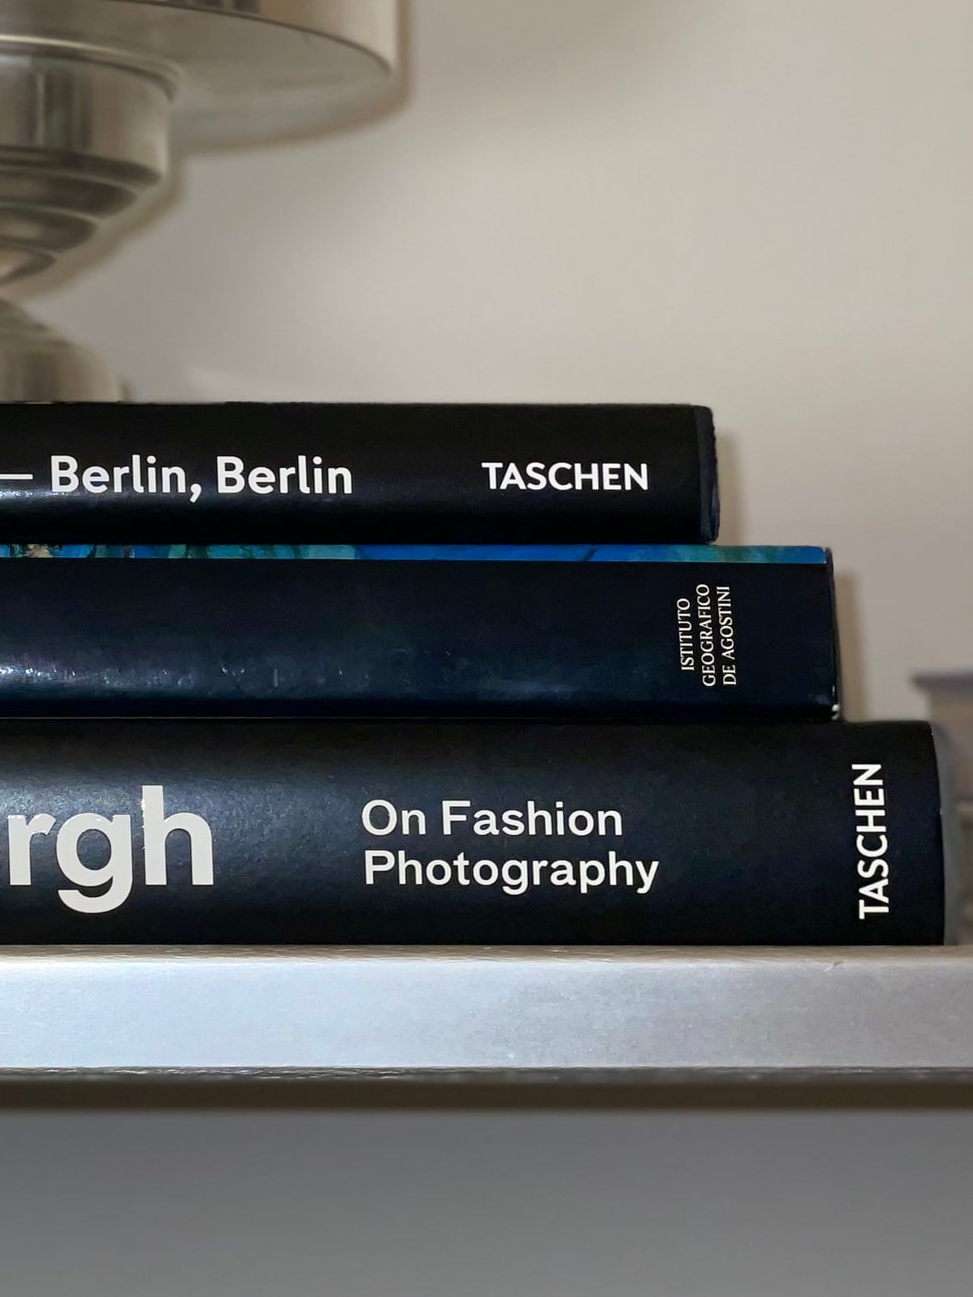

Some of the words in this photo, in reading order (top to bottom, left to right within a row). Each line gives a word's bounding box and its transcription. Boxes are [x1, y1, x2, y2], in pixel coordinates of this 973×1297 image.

[49, 455, 202, 501] Berlin,
[216, 455, 353, 495] Berlin
[481, 461, 649, 491] TASCHEN
[676, 598, 695, 671] ISTITUTO
[695, 583, 717, 687] GEOGRAFICO
[716, 586, 736, 660] AGOSTINI
[721, 664, 737, 686] DE
[361, 799, 426, 836] On
[441, 800, 624, 837] Fashion
[851, 762, 890, 921] TASCHEN
[364, 849, 660, 896] Photography
